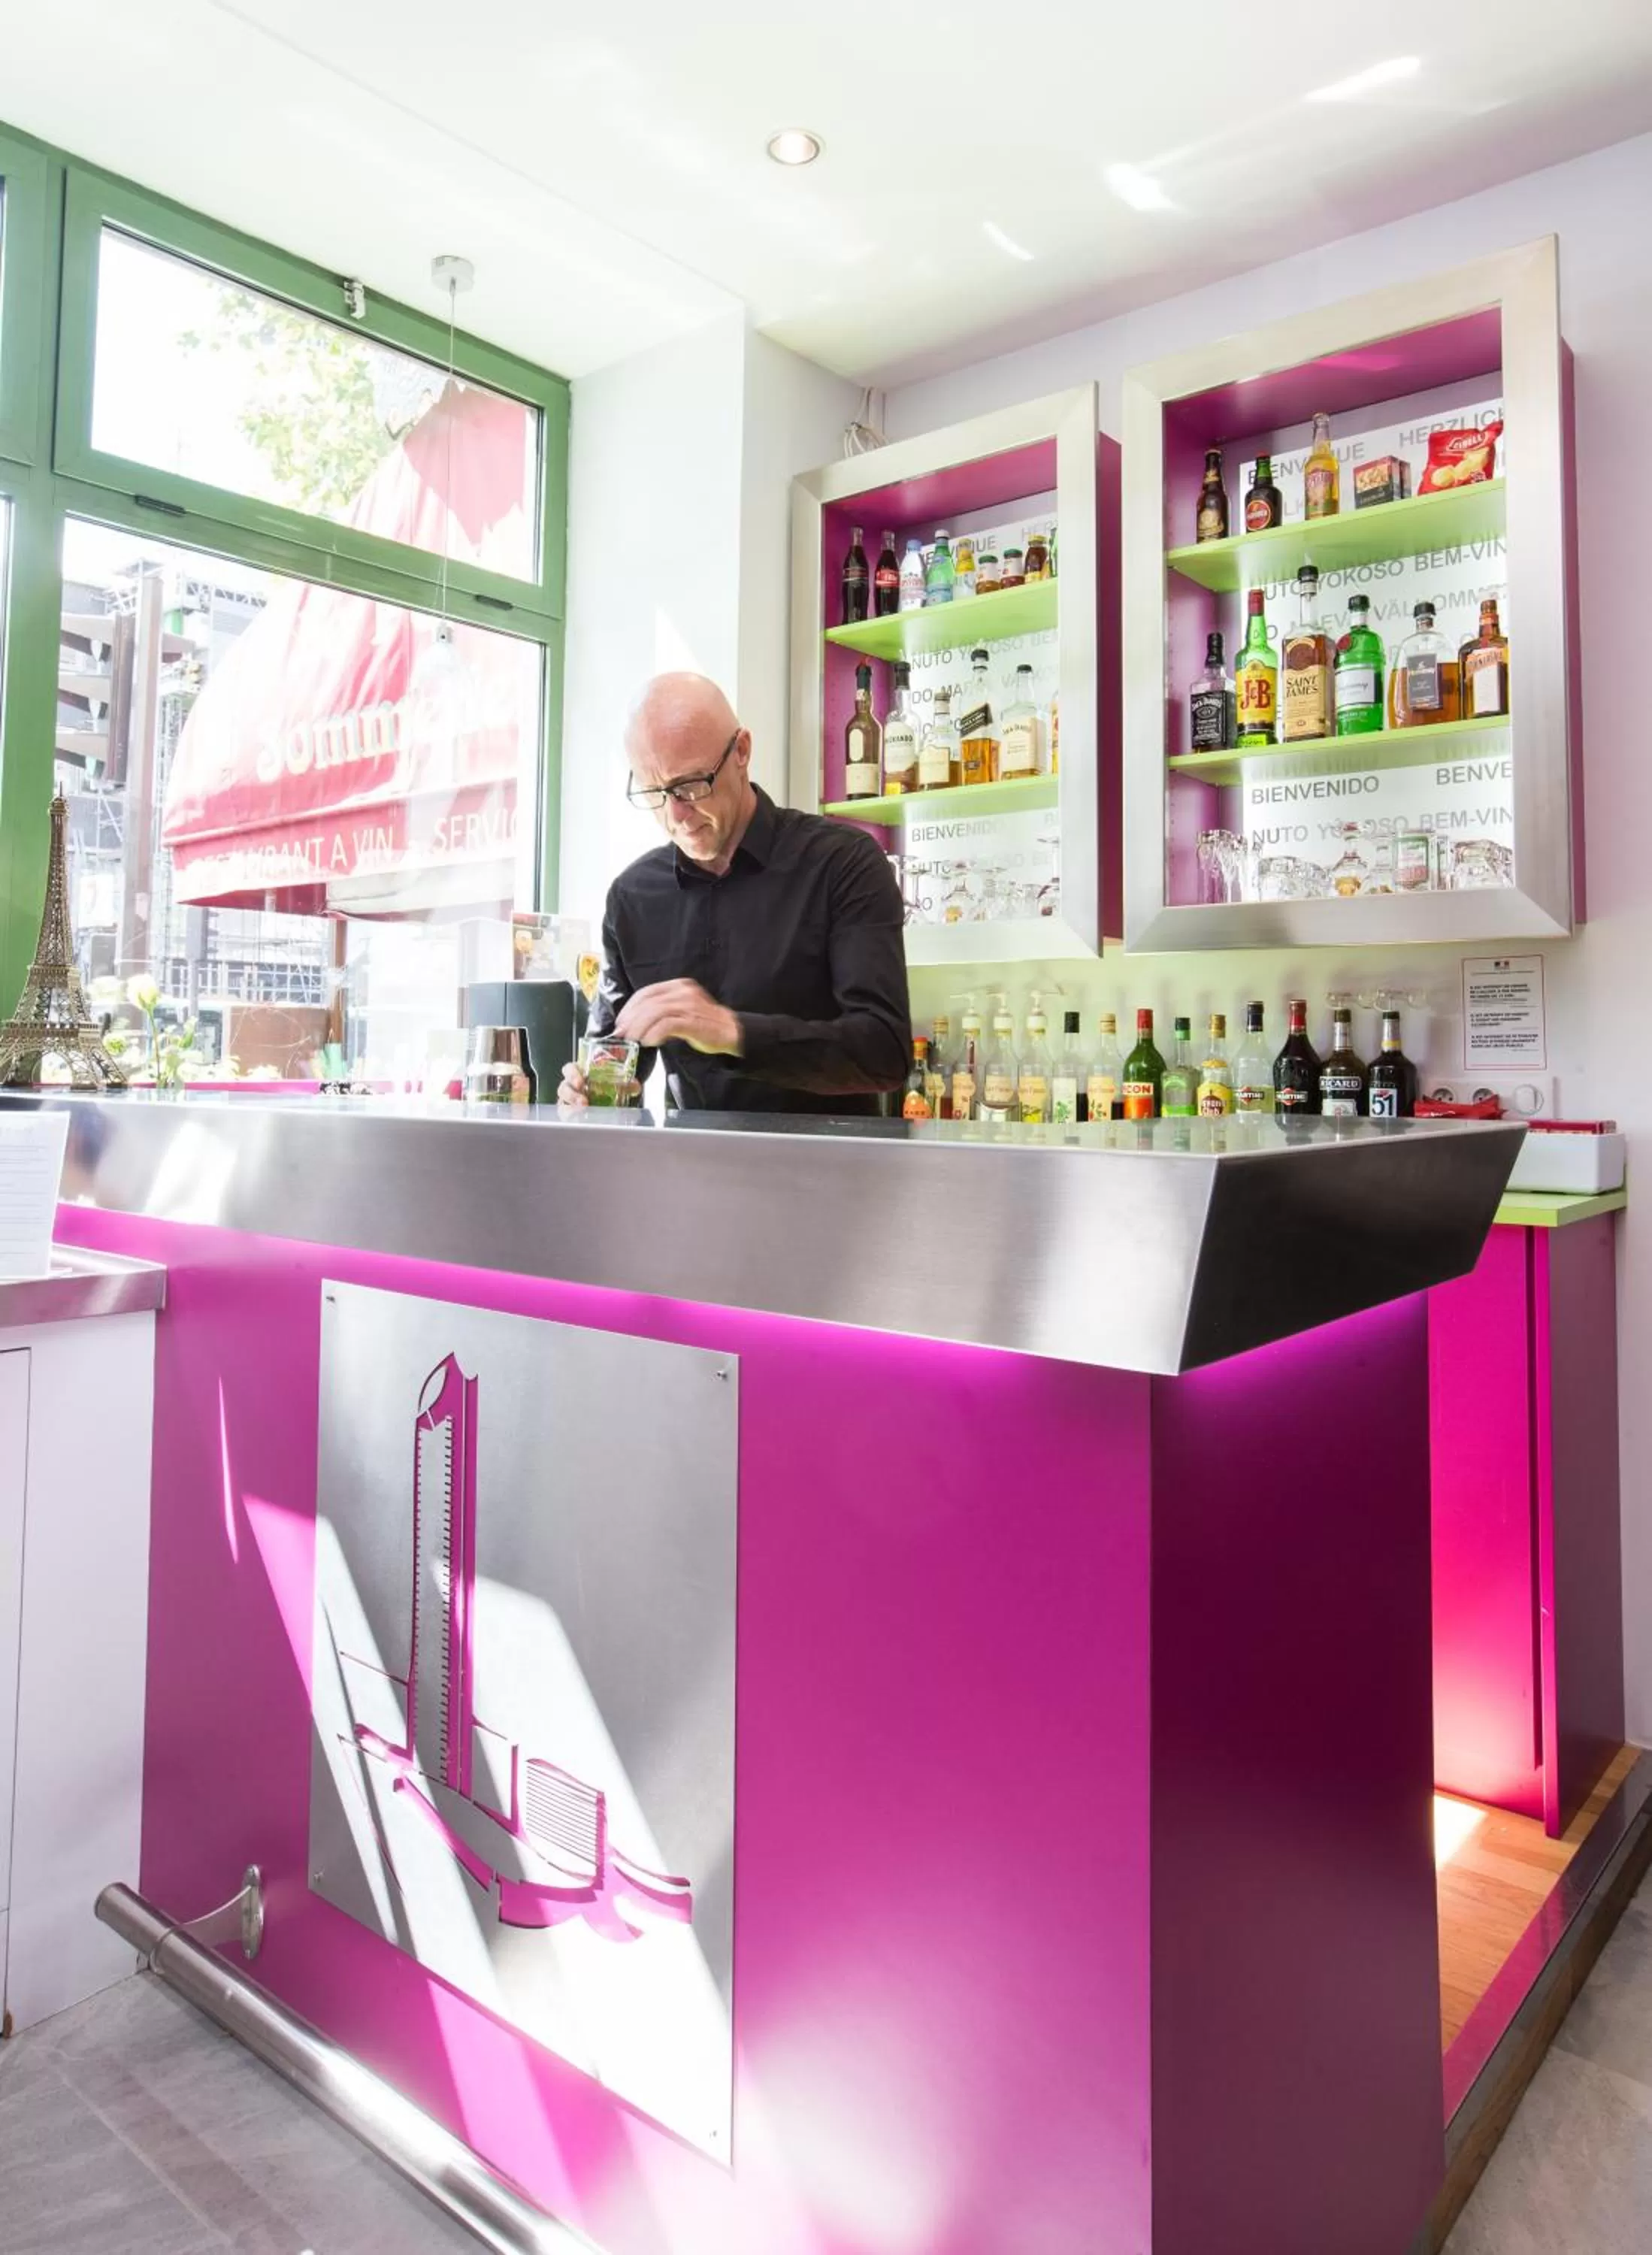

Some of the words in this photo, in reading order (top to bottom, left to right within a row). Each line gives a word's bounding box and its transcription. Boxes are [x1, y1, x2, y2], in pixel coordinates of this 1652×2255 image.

[1287, 675, 1318, 687] SAINT
[1287, 686, 1318, 698] JAMES
[1251, 776, 1380, 804] BIENVENIDO
[331, 834, 349, 870] A
[353, 826, 394, 866] VIN
[1372, 1094, 1394, 1116] 51
